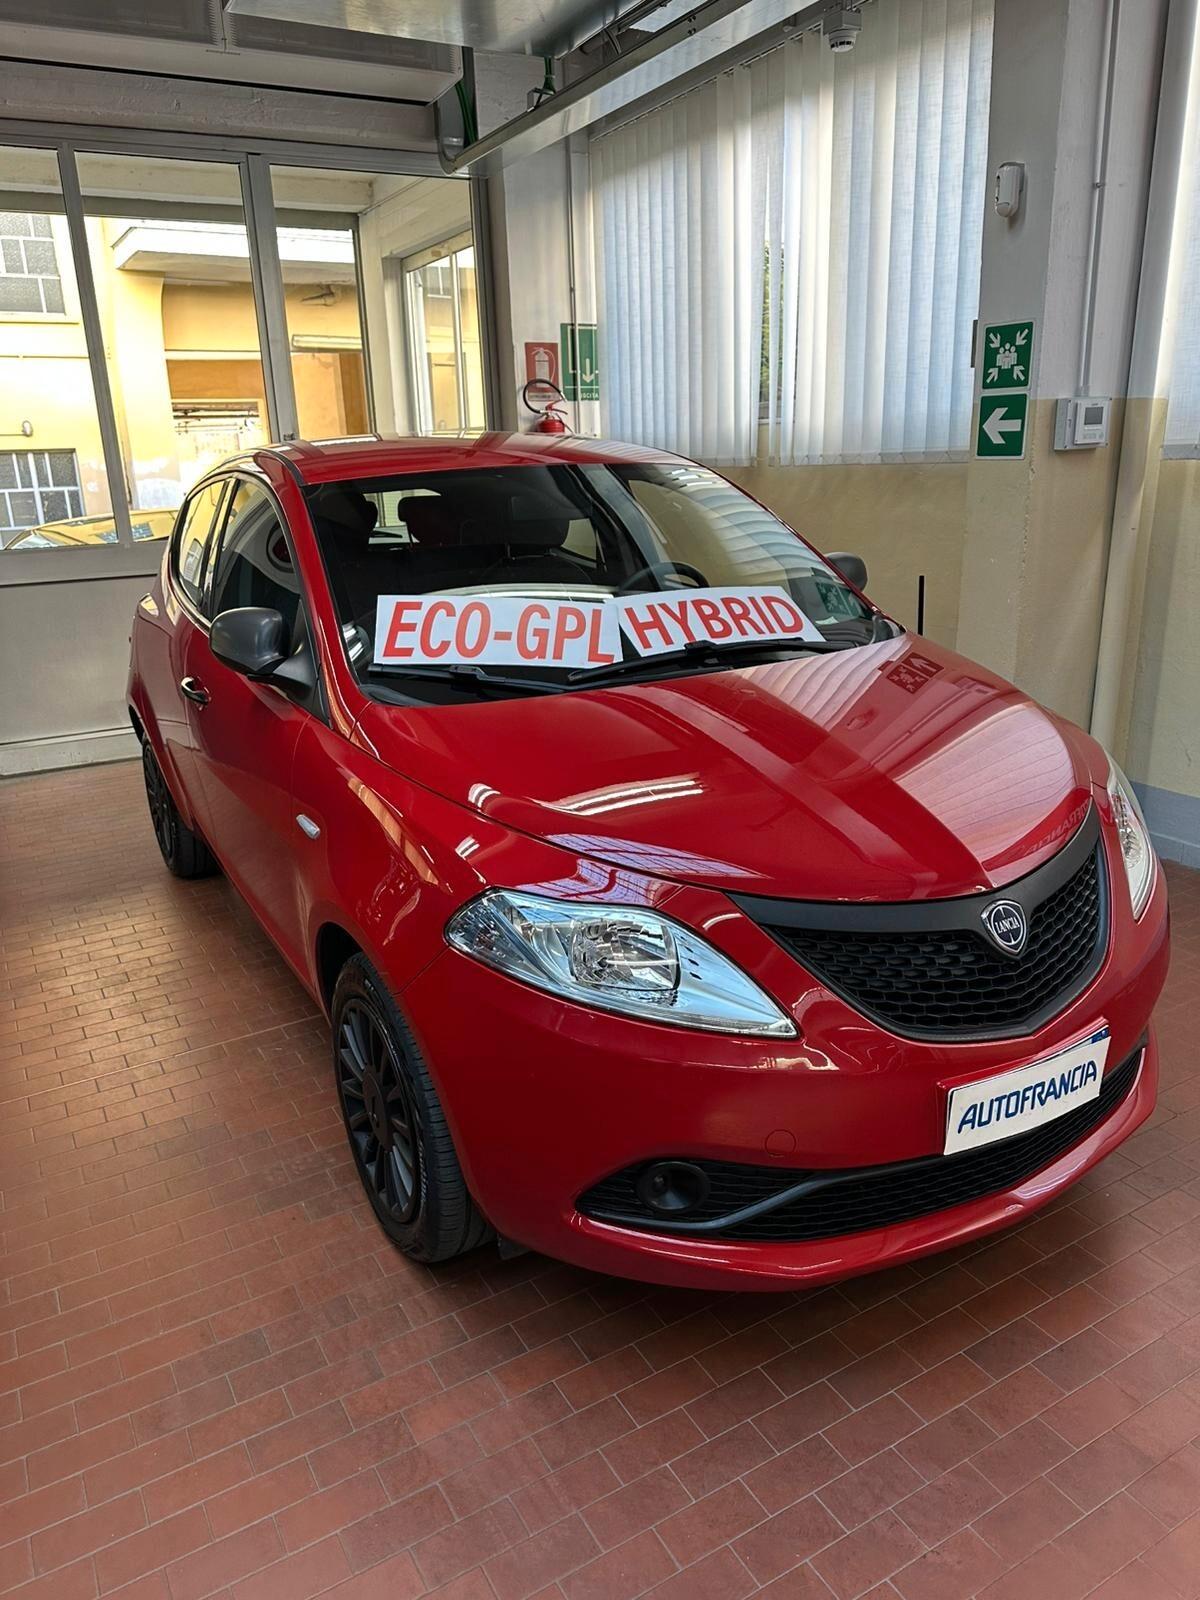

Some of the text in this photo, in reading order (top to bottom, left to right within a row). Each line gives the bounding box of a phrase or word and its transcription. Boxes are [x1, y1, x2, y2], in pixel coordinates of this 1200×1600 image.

[382, 600, 616, 664] ECO-GPL
[624, 595, 804, 650] HYBRID
[995, 917, 1020, 934] LANCIA
[957, 1060, 1098, 1134] AUTOFRANCIA
